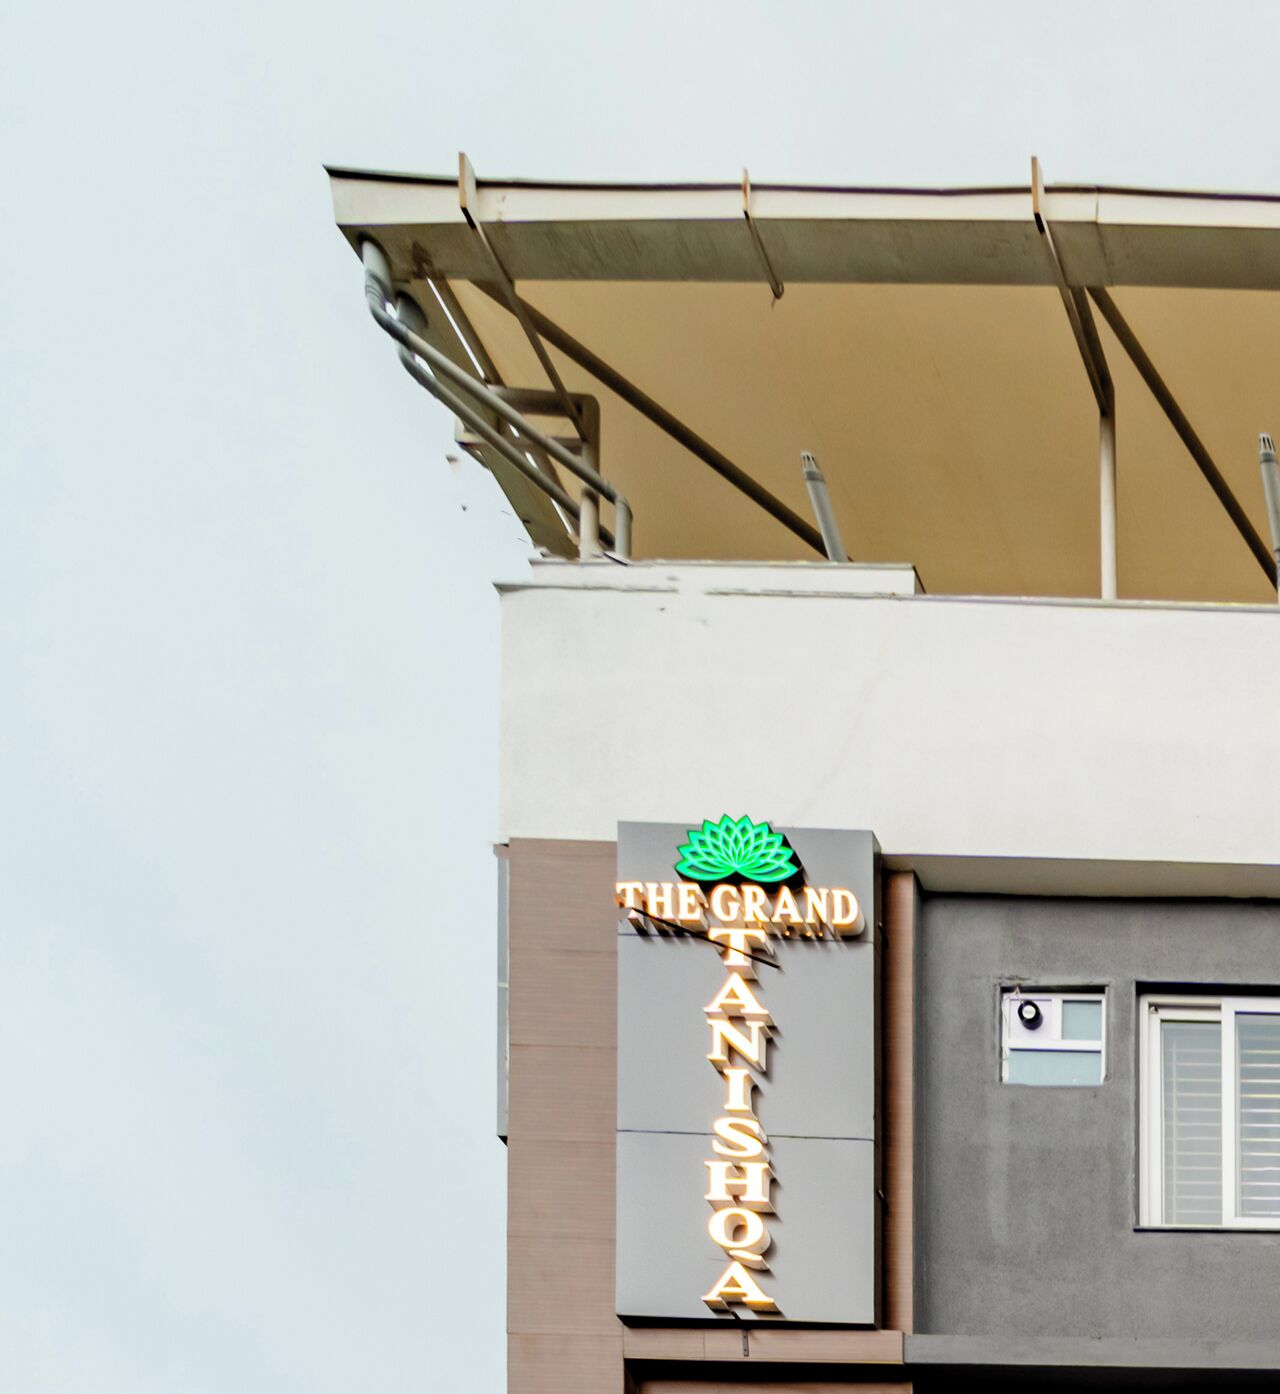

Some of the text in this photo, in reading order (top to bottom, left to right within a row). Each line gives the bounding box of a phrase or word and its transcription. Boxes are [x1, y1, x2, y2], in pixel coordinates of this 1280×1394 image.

[615, 881, 860, 926] THE GRAND
[702, 927, 776, 1303] TANISHQA
